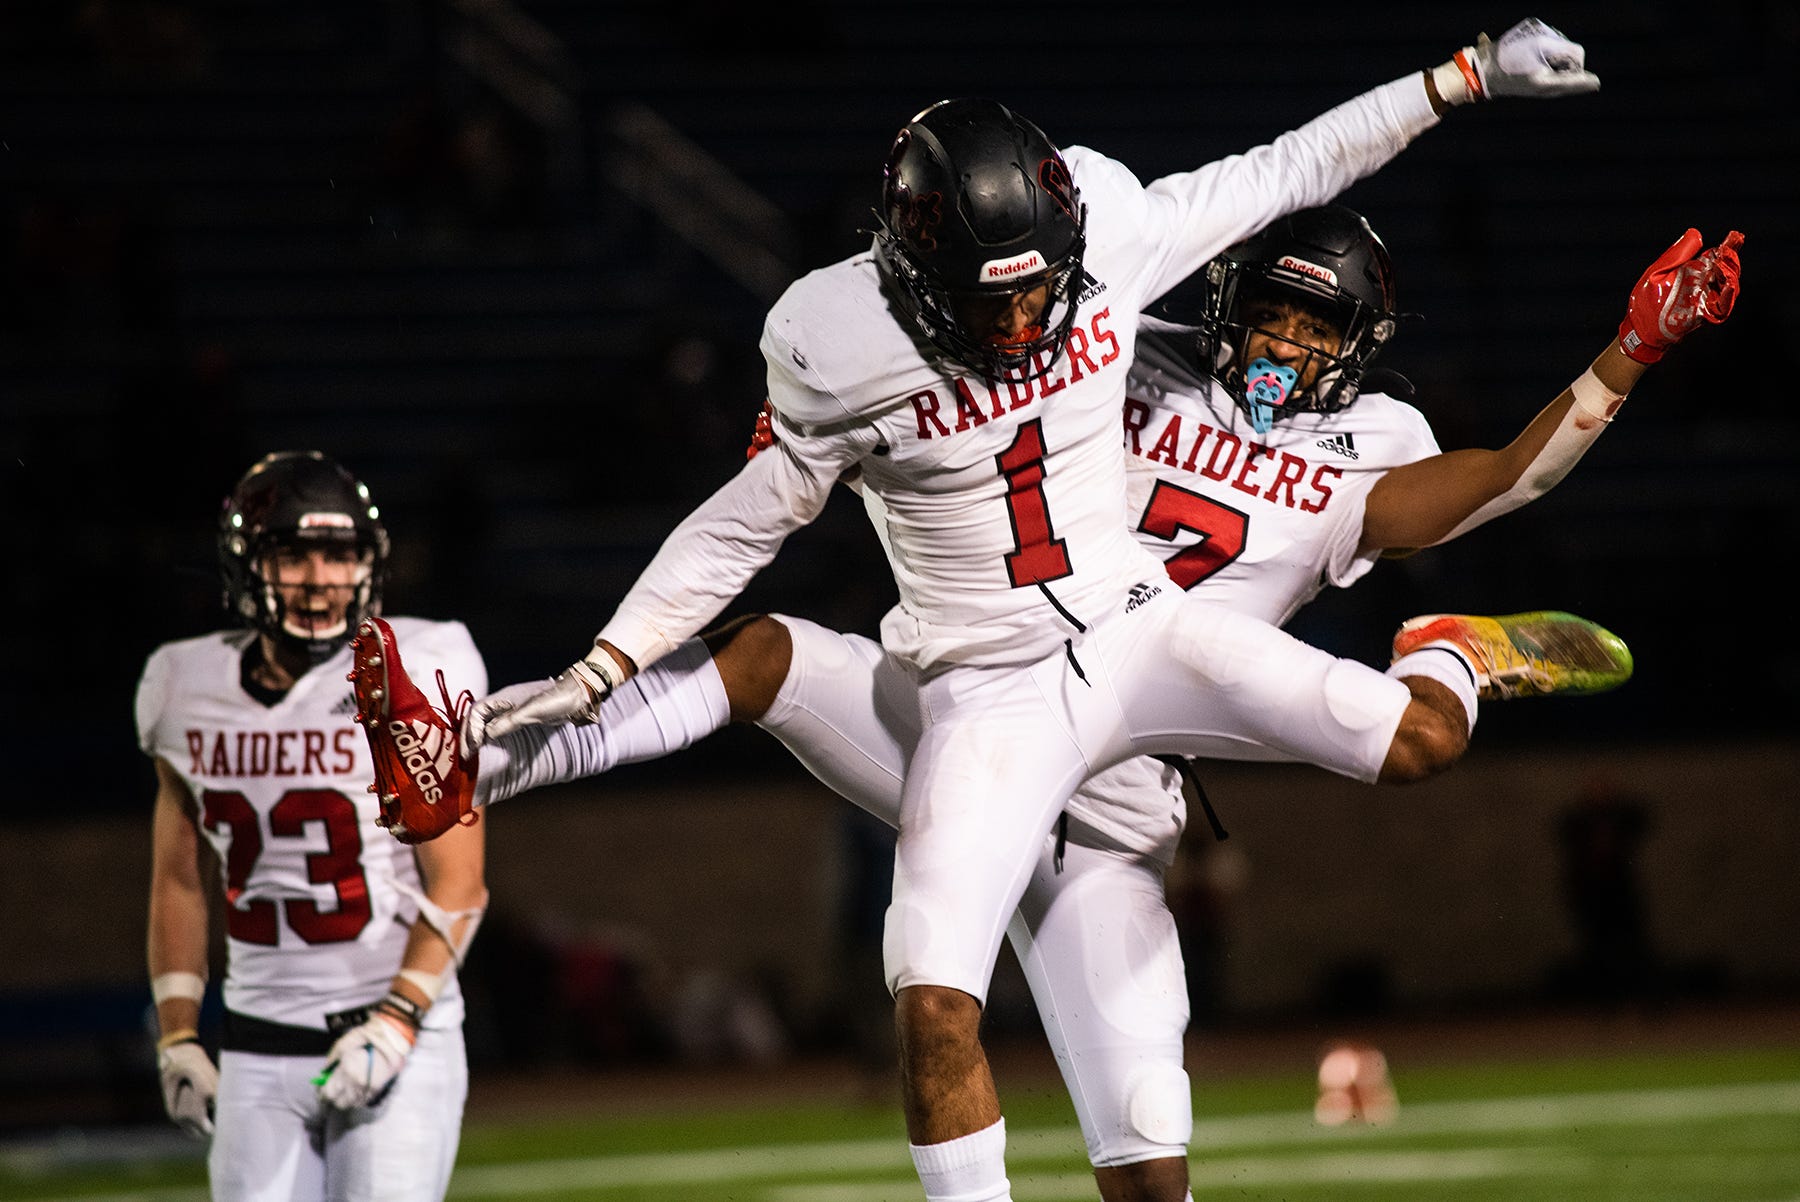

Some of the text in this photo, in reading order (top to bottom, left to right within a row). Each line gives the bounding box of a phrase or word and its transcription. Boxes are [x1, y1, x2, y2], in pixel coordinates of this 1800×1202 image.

[988, 256, 1038, 277] Riddell
[1077, 282, 1107, 305] didas
[1283, 258, 1332, 282] Riddell
[910, 307, 1120, 439] RAIDERS
[995, 417, 1074, 589] 1
[1123, 397, 1343, 514] RAIDERS
[1137, 478, 1250, 592] 7
[186, 728, 356, 777] RAIDERS
[388, 720, 443, 805] adidas
[203, 788, 373, 947] 23
